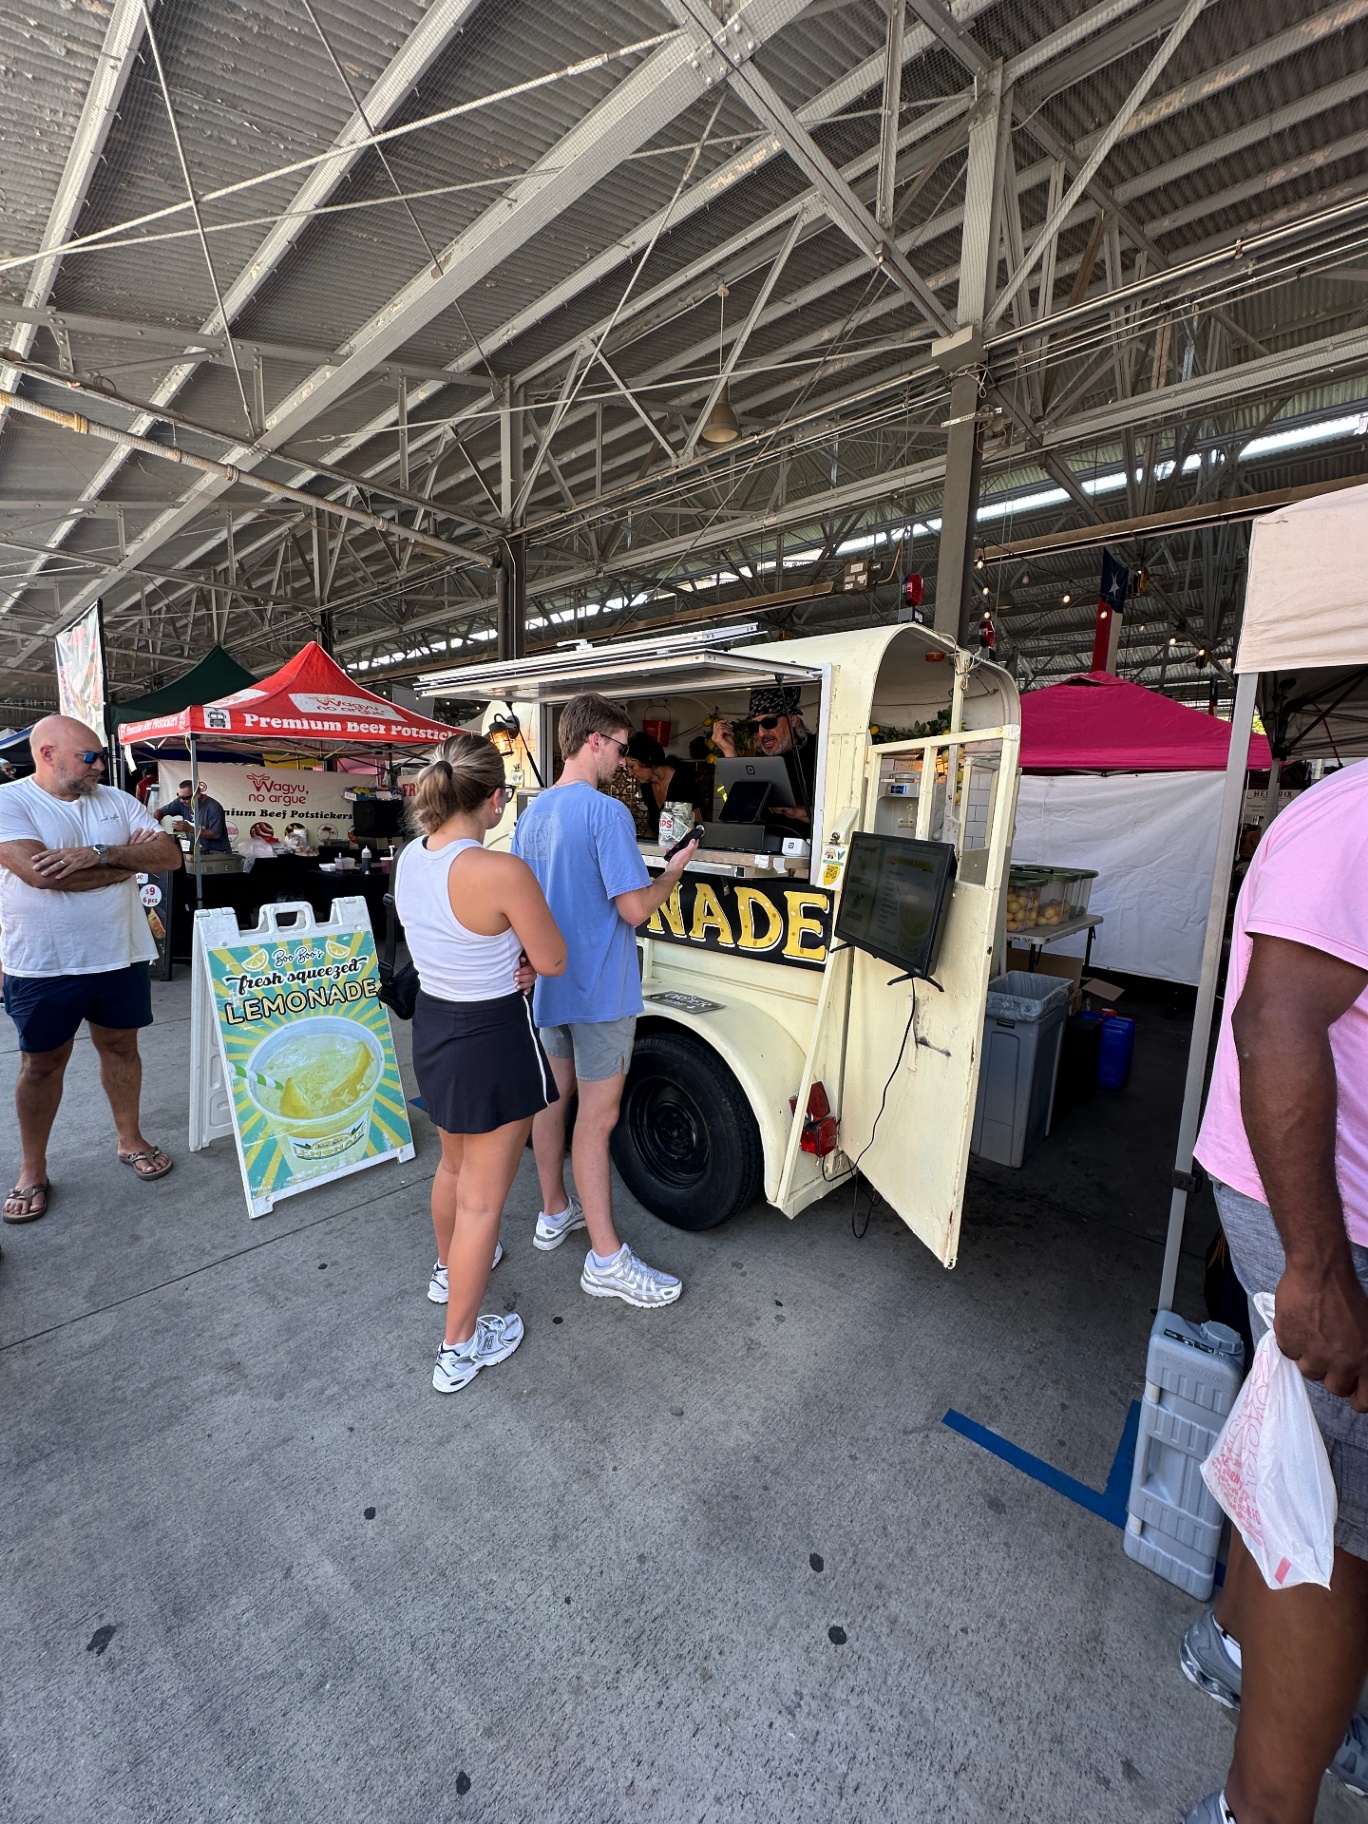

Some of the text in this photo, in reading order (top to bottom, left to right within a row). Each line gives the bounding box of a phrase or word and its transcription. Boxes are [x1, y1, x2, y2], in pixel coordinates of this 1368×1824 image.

[243, 713, 341, 731] Premium
[248, 793, 307, 807] no argue
[259, 809, 287, 819] Beef
[290, 810, 354, 820] Potstickers
[145, 887, 156, 896] $9
[272, 946, 325, 967] Boo Boo's
[225, 957, 368, 995] fresh squeezed
[224, 977, 378, 1025] LEMONADE
